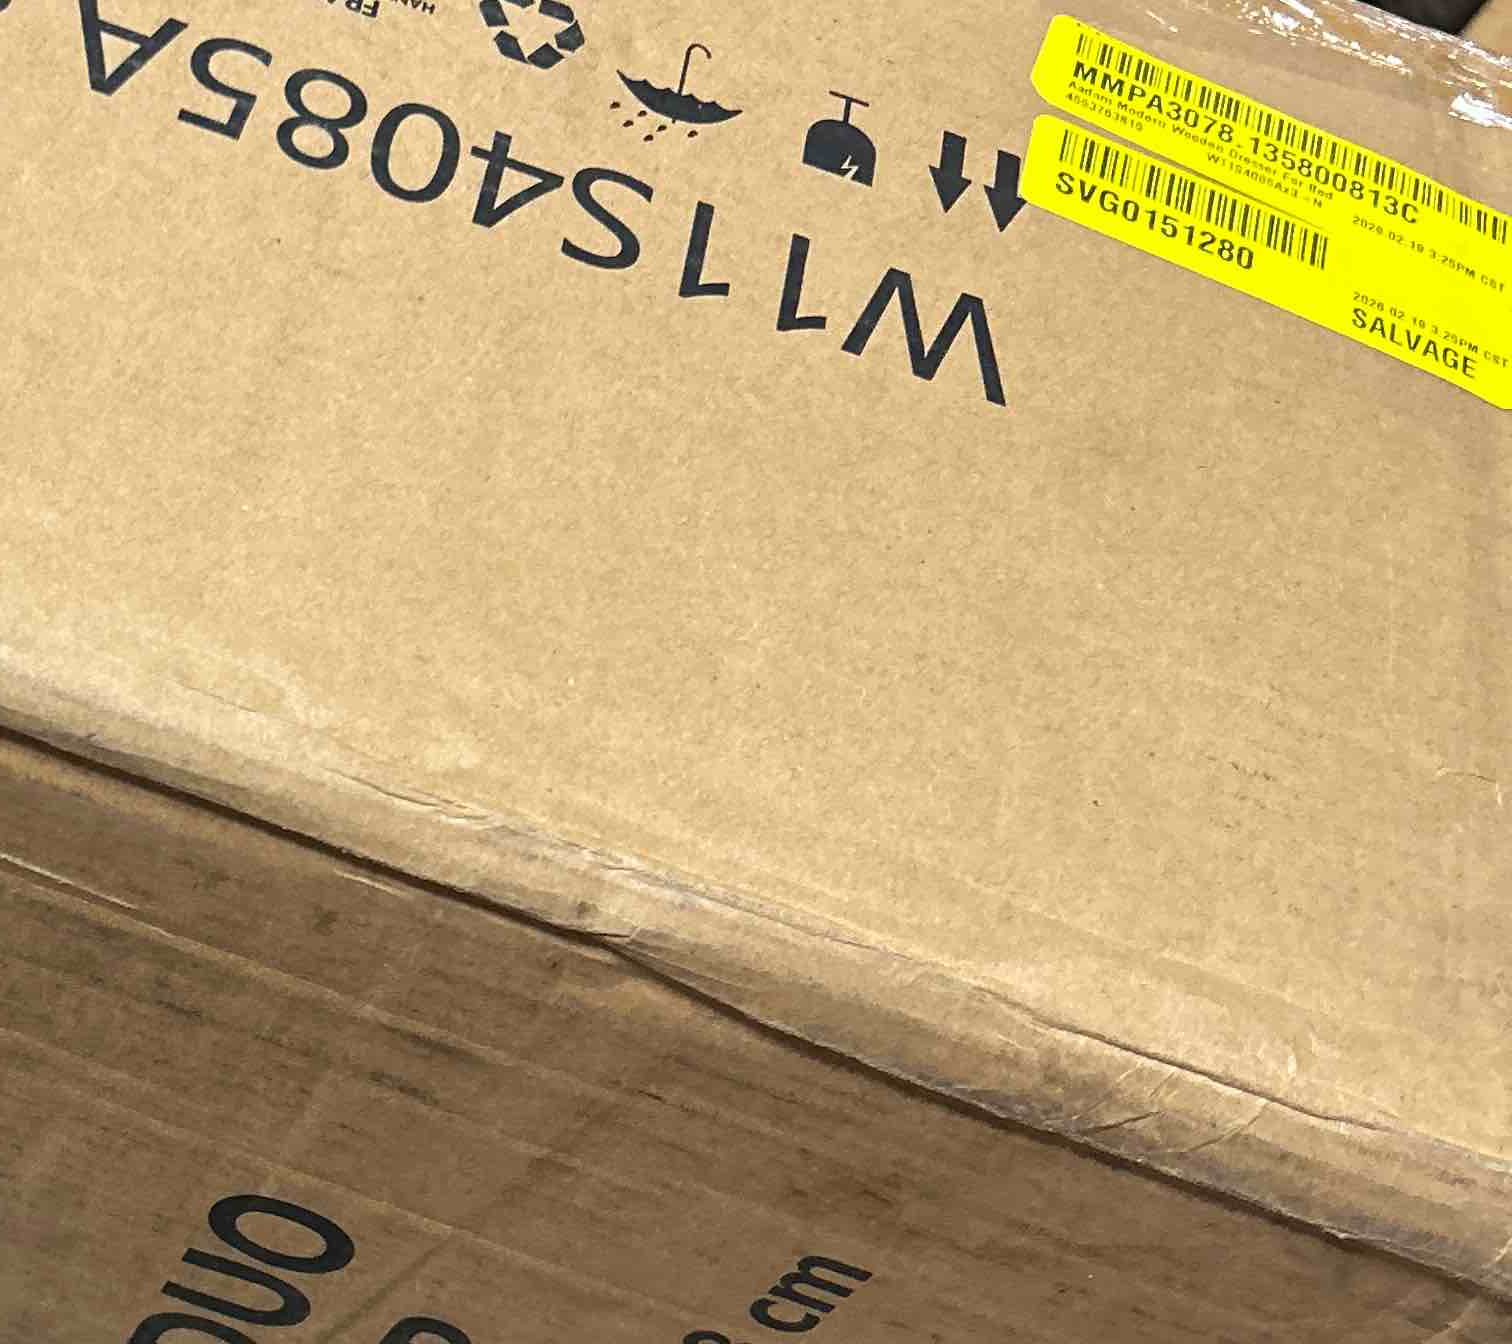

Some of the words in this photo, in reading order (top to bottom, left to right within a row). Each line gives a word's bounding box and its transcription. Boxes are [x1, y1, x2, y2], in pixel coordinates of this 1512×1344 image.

[1072, 61, 1419, 224] MMPA3078.135800813C
[1055, 171, 1256, 271] SVG0151280
[1352, 307, 1478, 378] SALVAGE
[748, 1254, 874, 1335] cm
